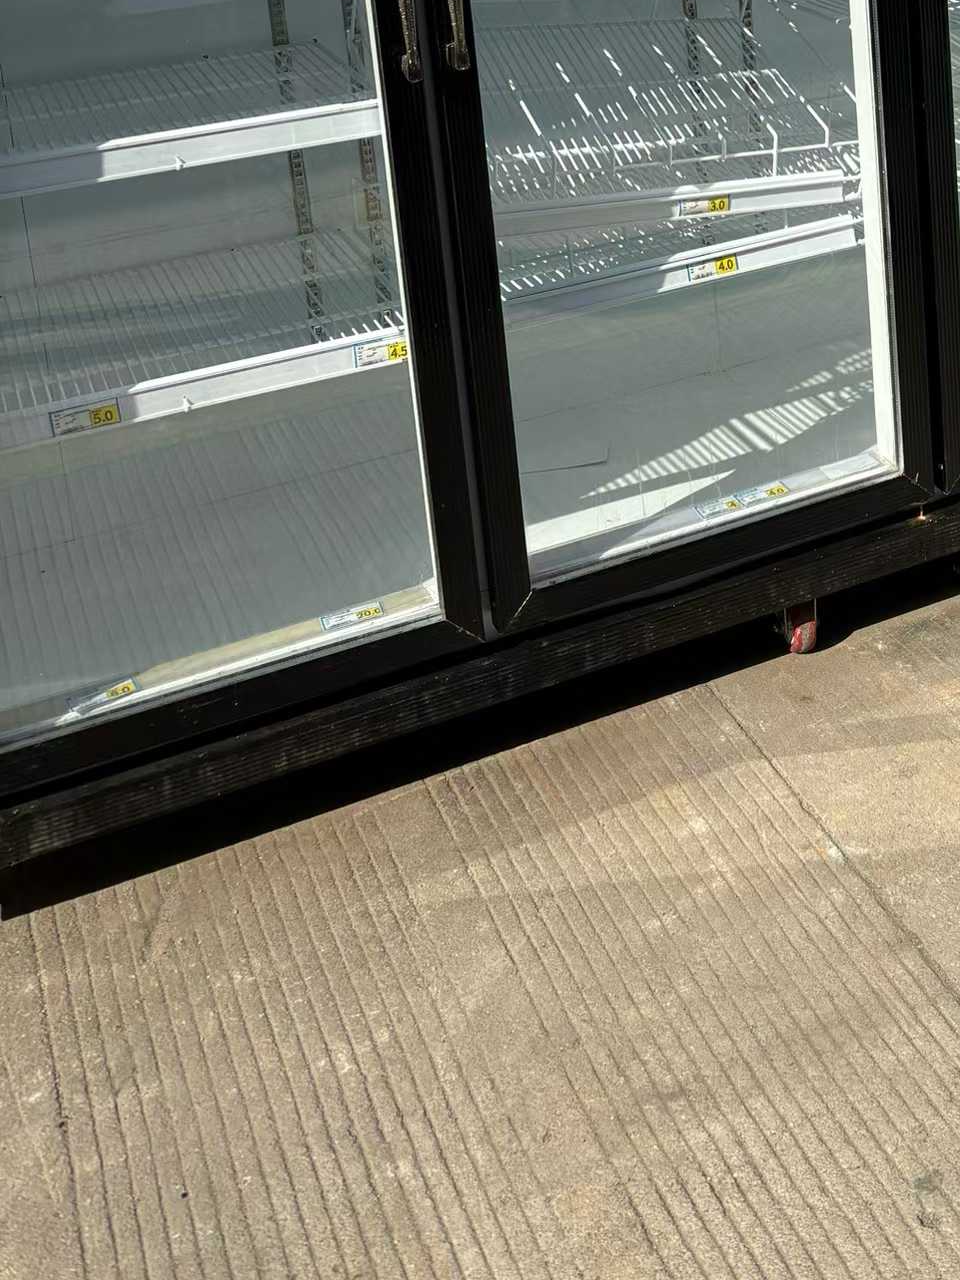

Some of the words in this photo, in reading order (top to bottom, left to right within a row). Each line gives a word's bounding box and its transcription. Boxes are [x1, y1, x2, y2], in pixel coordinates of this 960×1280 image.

[711, 201, 726, 211] 3.0
[718, 259, 733, 270] 4.0
[391, 345, 408, 358] 4.5
[94, 410, 114, 423] 5.0
